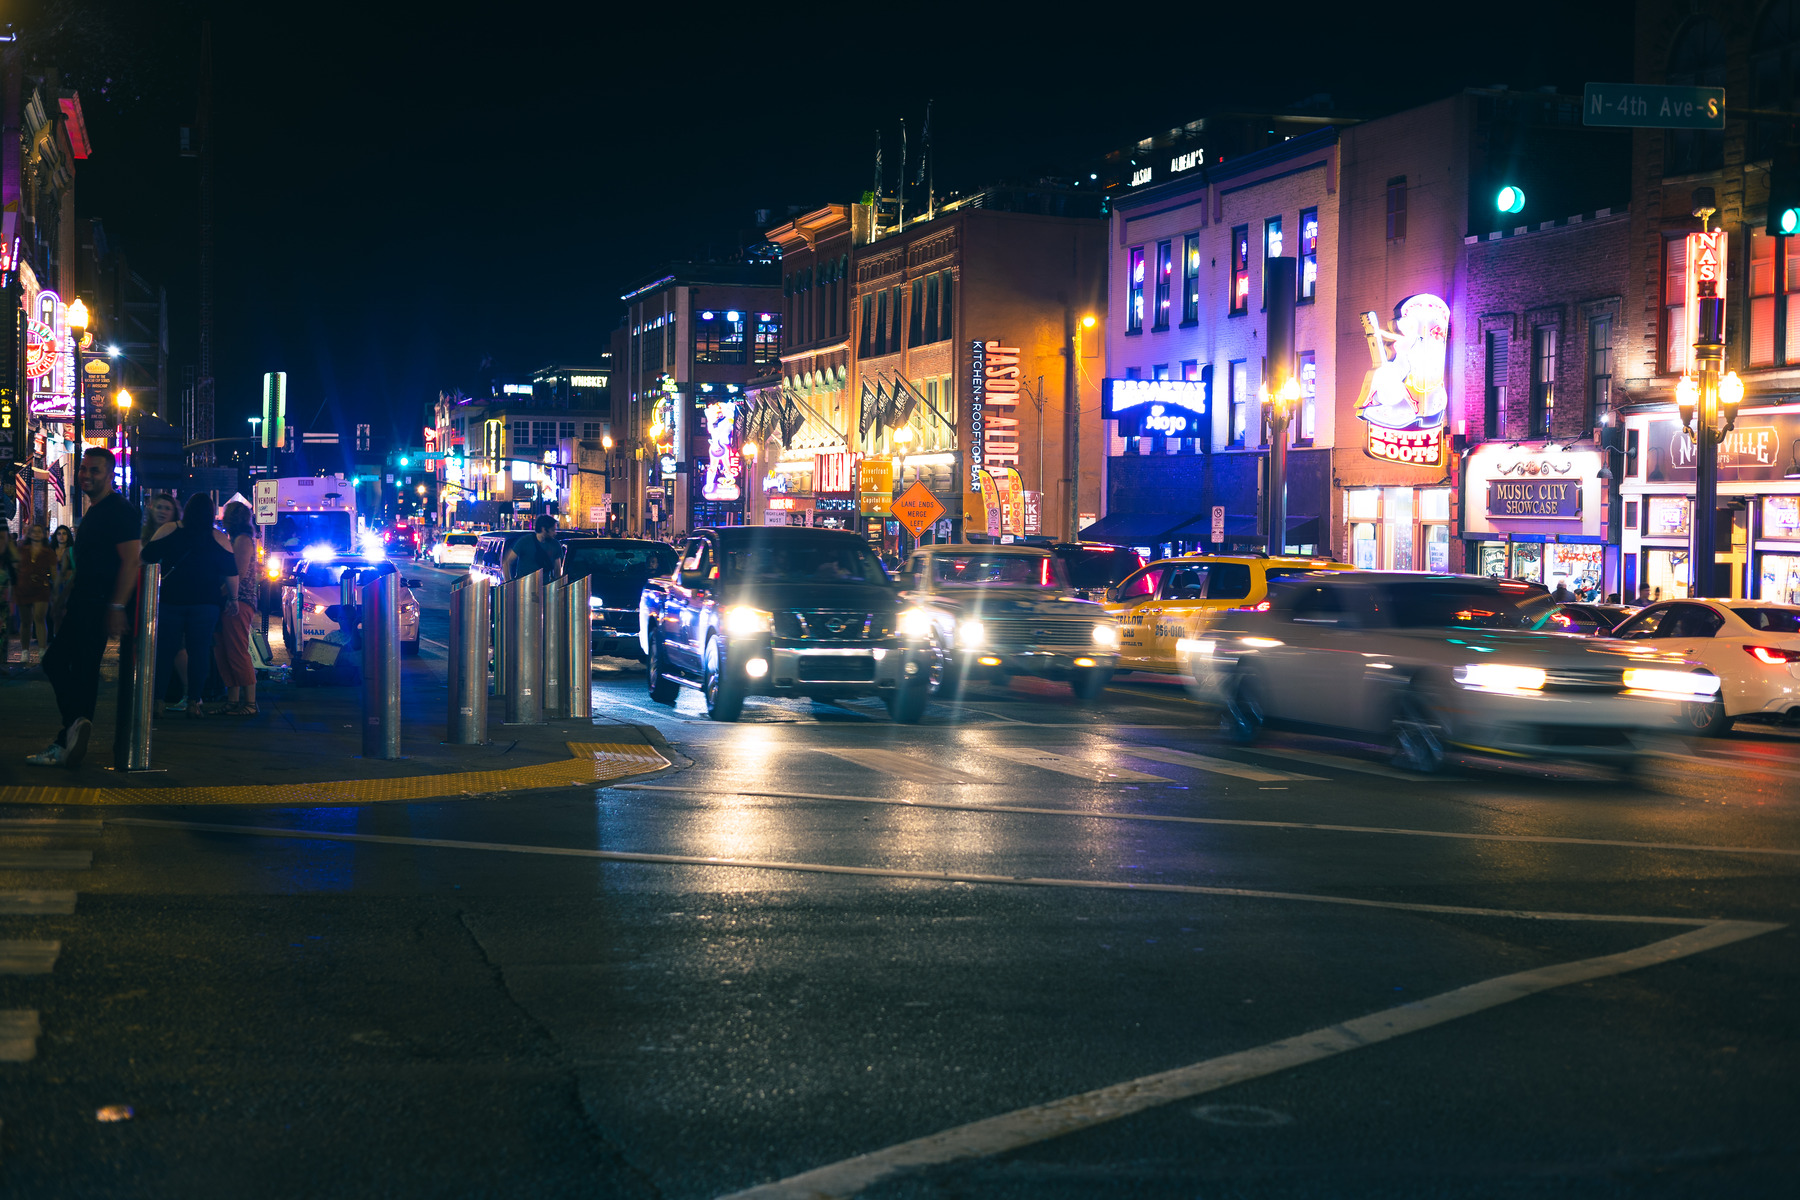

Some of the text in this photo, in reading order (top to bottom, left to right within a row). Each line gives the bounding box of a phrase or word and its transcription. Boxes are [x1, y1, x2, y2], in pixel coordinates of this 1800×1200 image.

[1170, 148, 1204, 173] ALDEAN'S
[1132, 167, 1152, 187] JASON
[973, 341, 982, 394] KITCHEN
[985, 340, 1020, 406] JASON
[571, 375, 607, 387] WHISKEY
[91, 395, 105, 403] ally
[972, 403, 981, 465] ROOFTOP
[1370, 424, 1441, 445] BETTY
[1370, 439, 1439, 463] BOOTS
[862, 467, 889, 475] Riverfront
[971, 465, 981, 491] BAR
[982, 476, 994, 500] HOT
[1497, 484, 1568, 500] MUSIC CITY
[862, 496, 881, 504] Capitol
[1506, 501, 1558, 514] SHOWCASE
[1115, 615, 1144, 626] YELLOW
[1122, 628, 1135, 637] CAB
